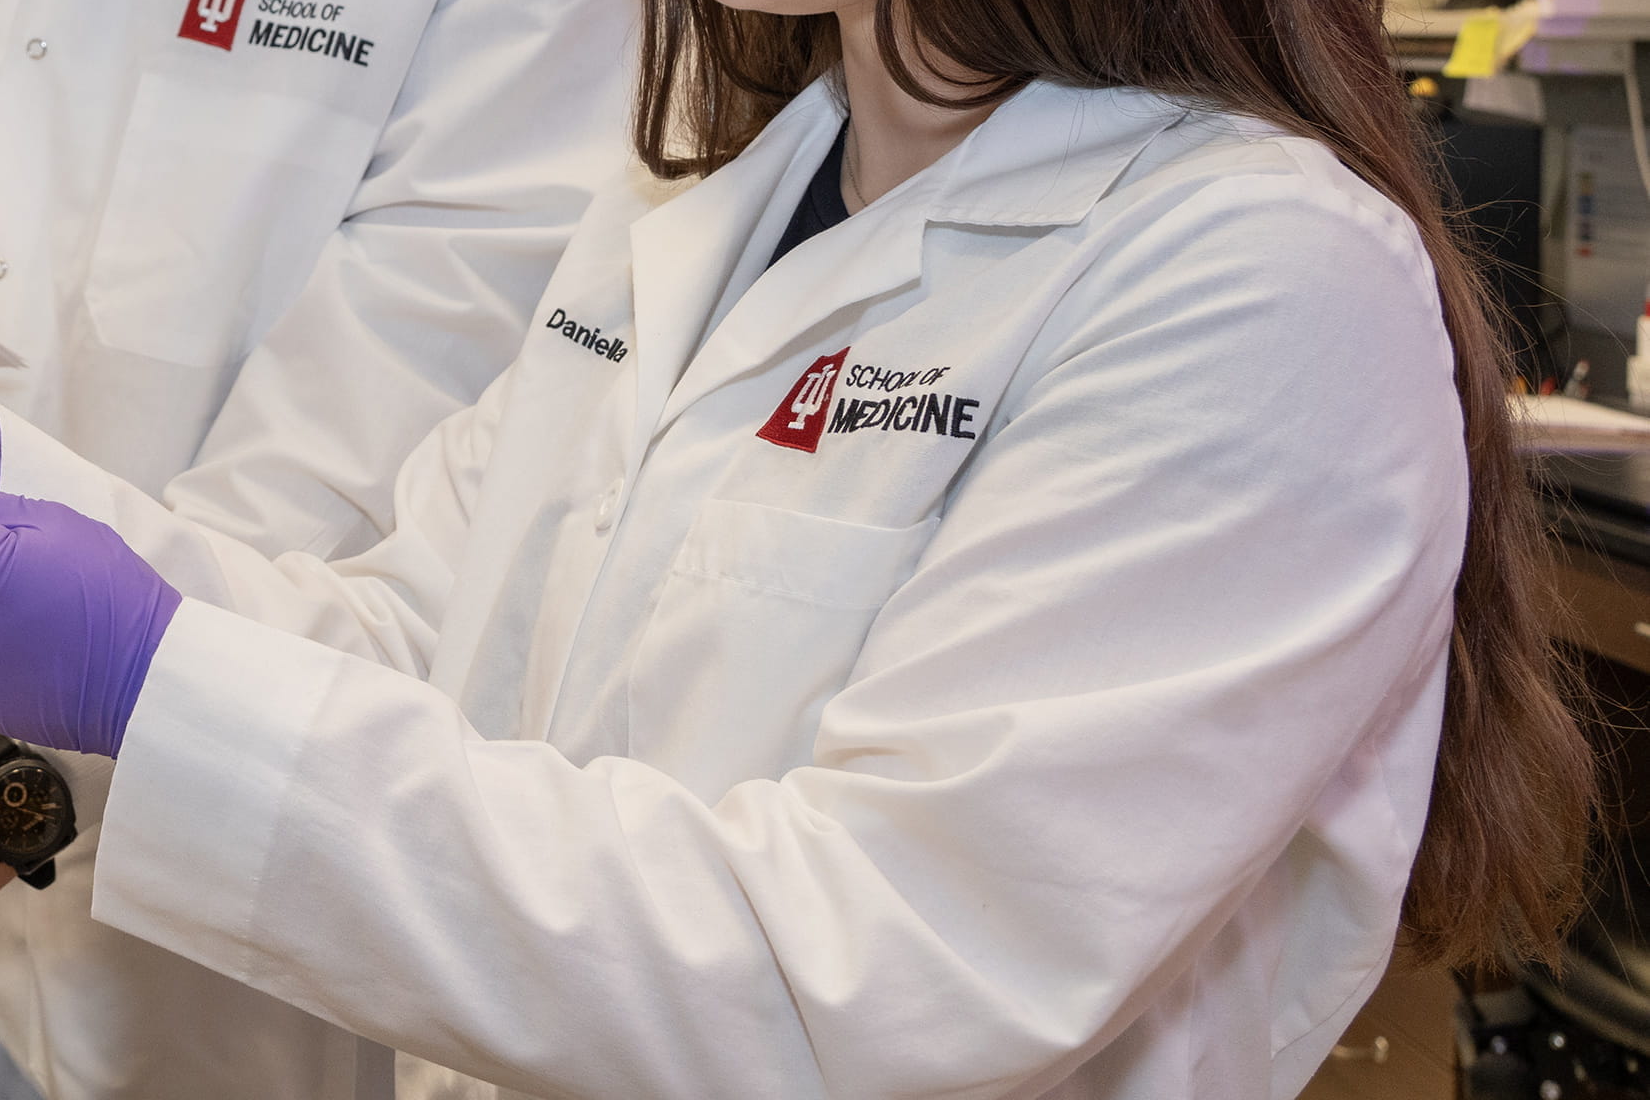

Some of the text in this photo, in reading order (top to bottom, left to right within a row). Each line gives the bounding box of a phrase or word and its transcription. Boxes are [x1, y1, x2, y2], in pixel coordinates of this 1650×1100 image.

[321, 3, 345, 22] OF
[248, 19, 374, 67] MEDICINE
[546, 308, 628, 363] Daniella
[846, 364, 951, 392] SCHOOL OF
[827, 393, 980, 440] MEDICINE
